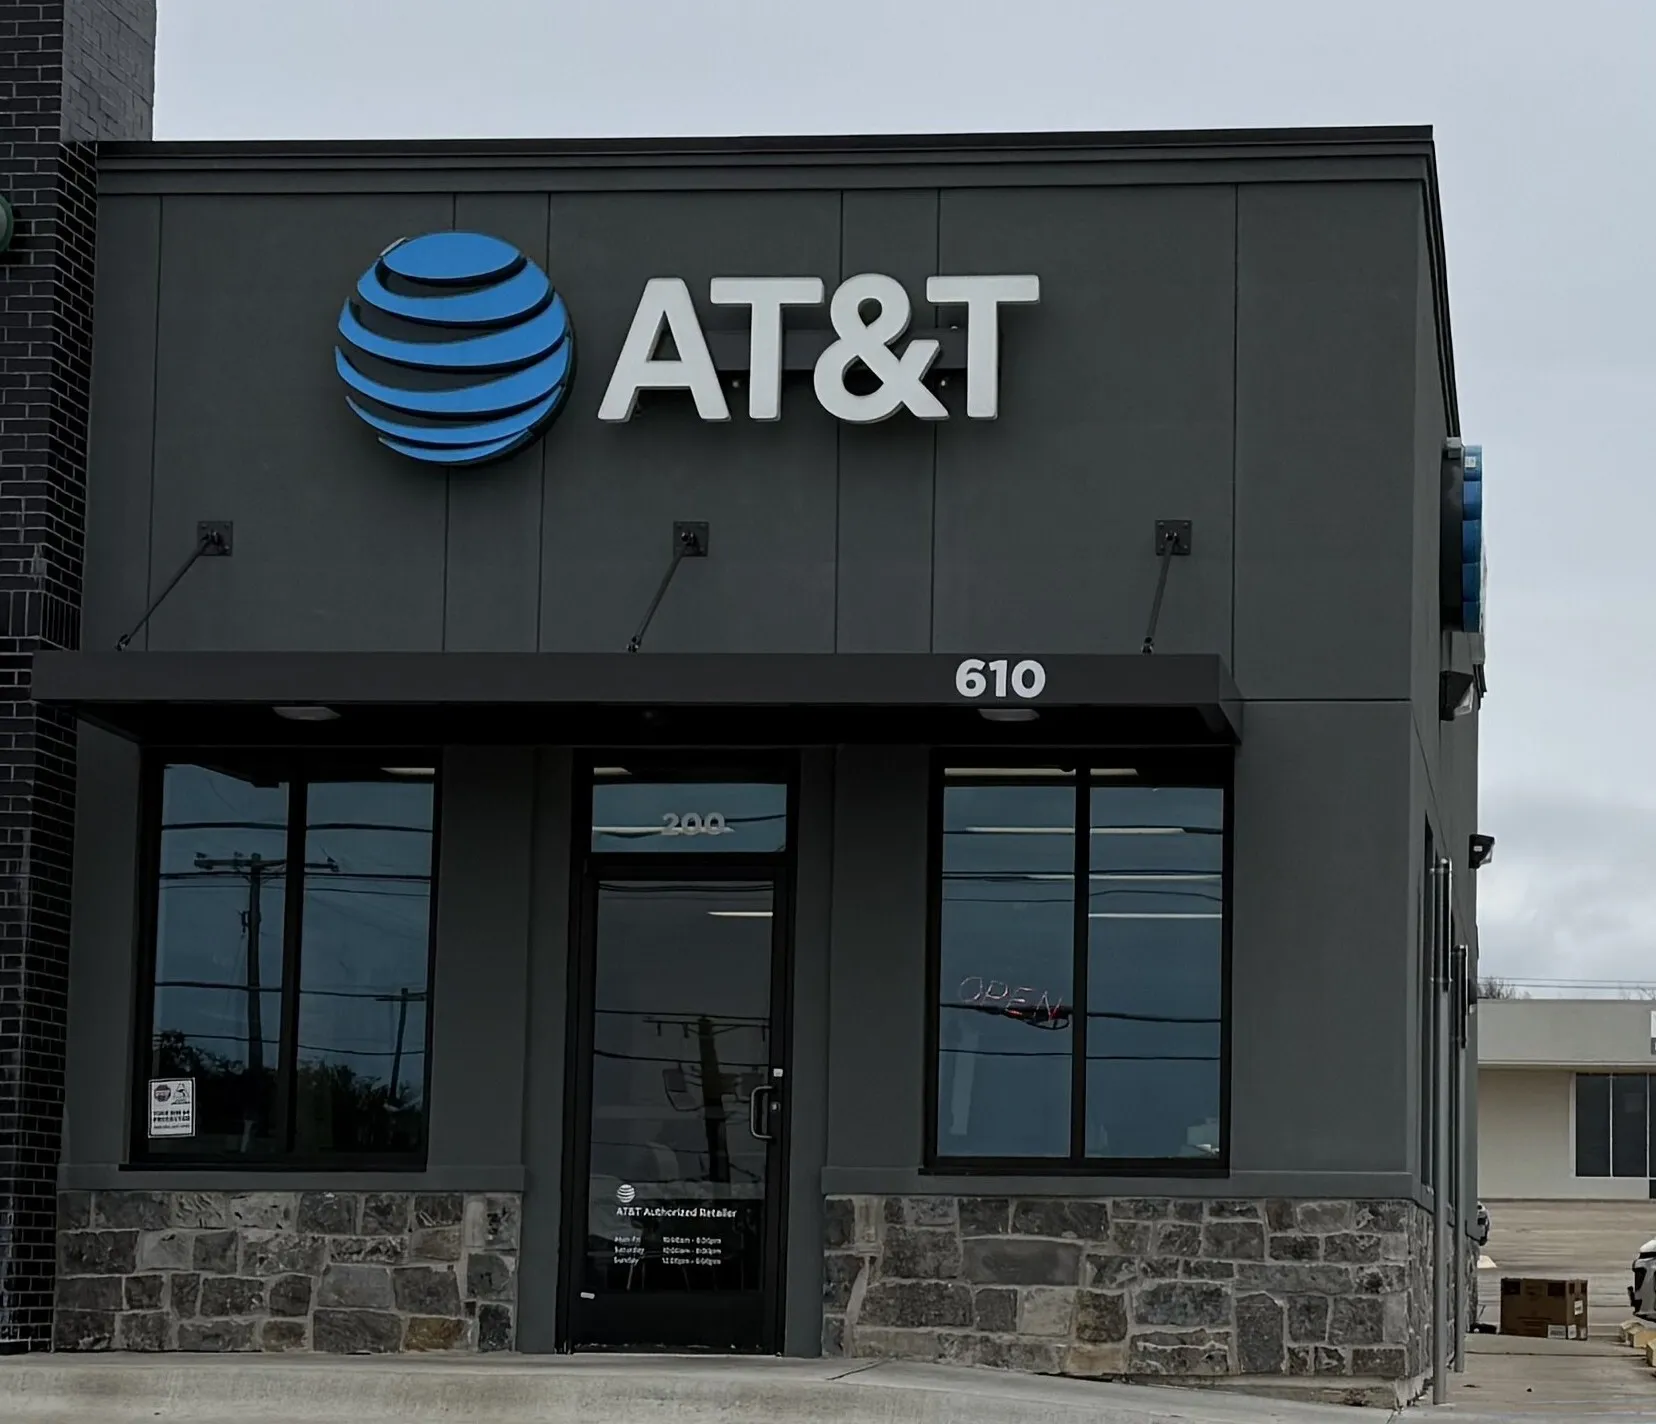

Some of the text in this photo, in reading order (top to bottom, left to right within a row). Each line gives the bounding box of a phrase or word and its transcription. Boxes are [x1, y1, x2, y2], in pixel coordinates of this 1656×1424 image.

[597, 273, 1040, 424] AT&T
[955, 658, 1046, 698] 610
[661, 812, 726, 836] 200
[958, 976, 1064, 1022] OPEN
[616, 1207, 737, 1218] AT&T Authorized Retailer
